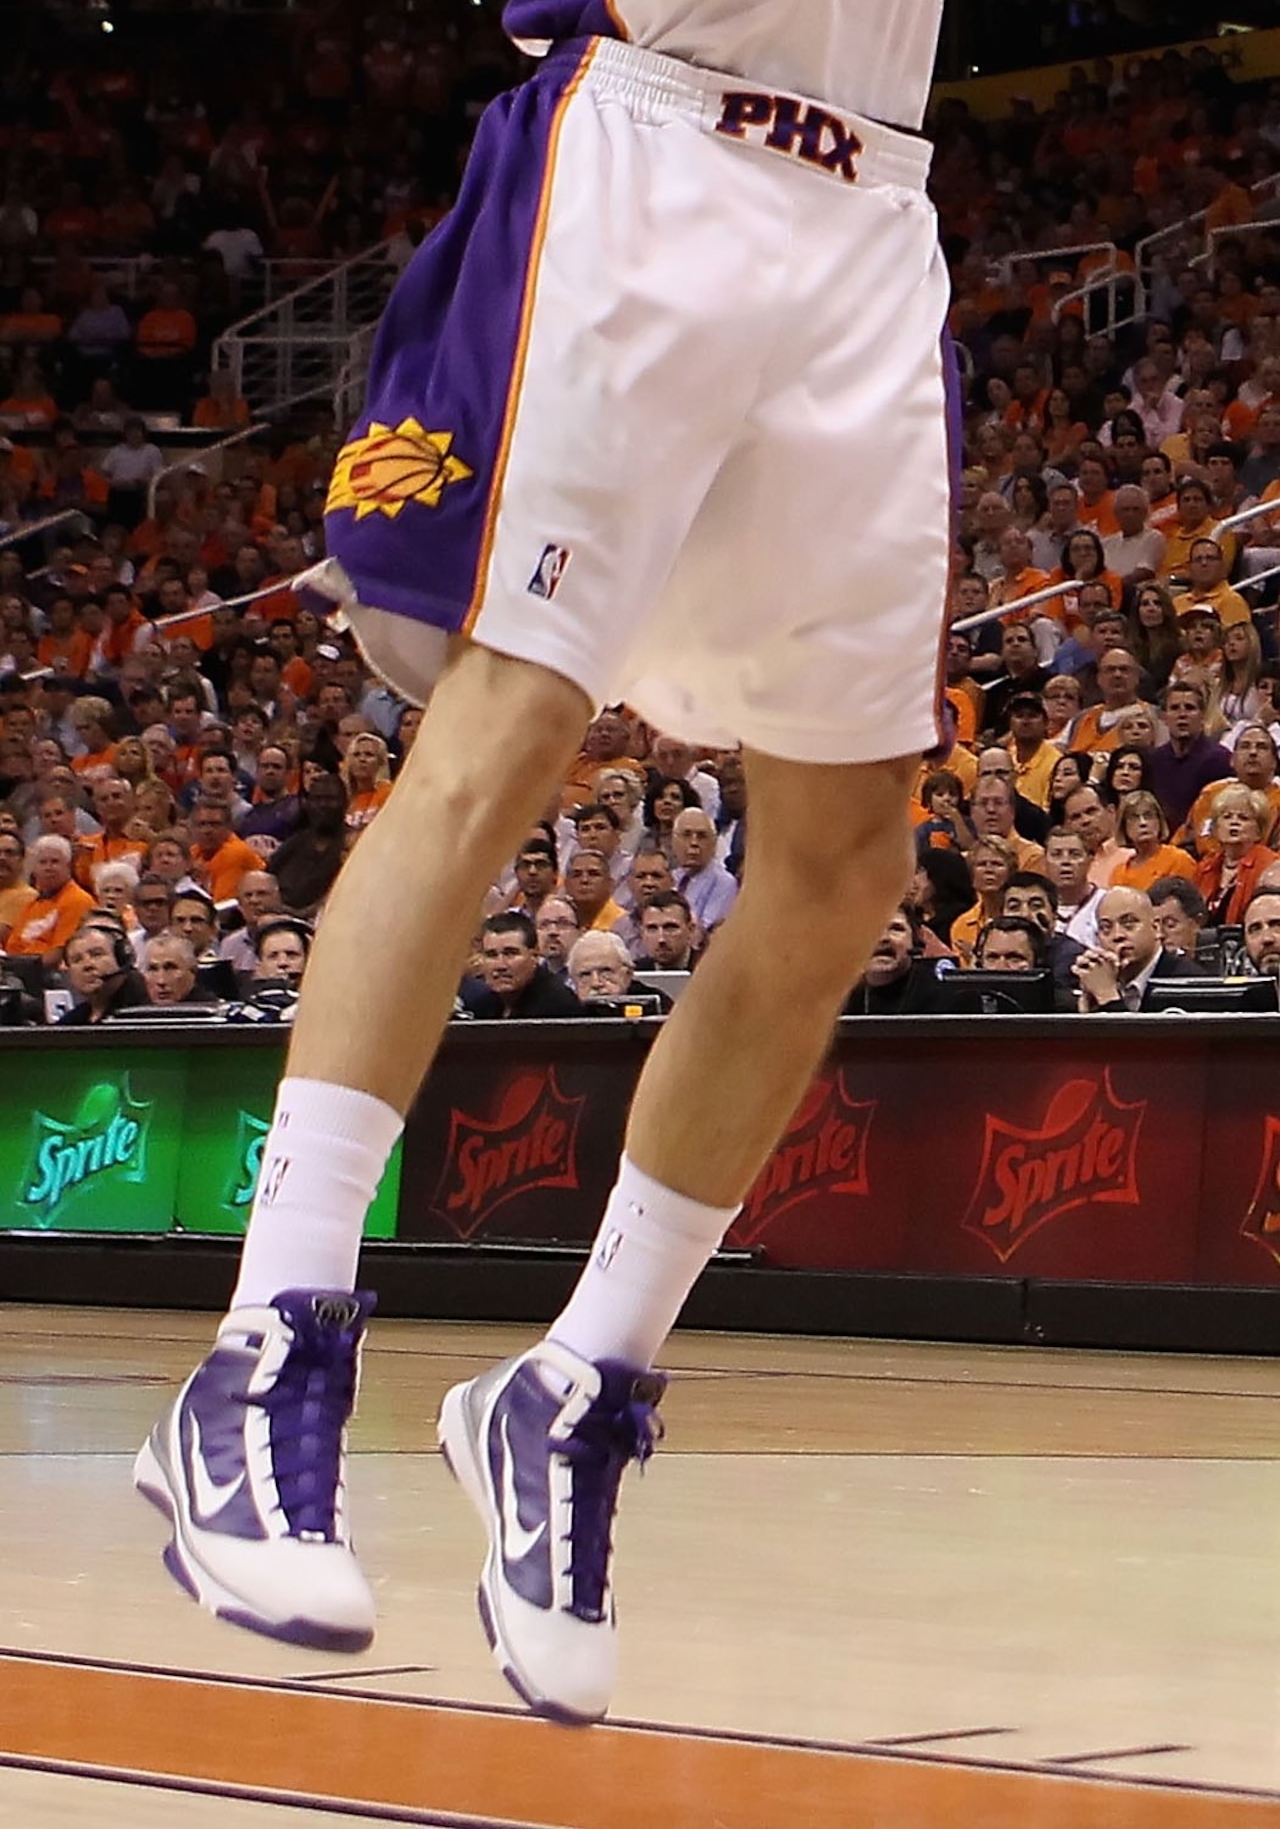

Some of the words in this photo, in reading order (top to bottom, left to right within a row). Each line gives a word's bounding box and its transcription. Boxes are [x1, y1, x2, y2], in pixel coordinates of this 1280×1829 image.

[715, 90, 864, 182] PHX
[27, 1107, 139, 1207] Sprite
[447, 1102, 568, 1214] Sprite
[982, 1112, 1126, 1233] Sprite
